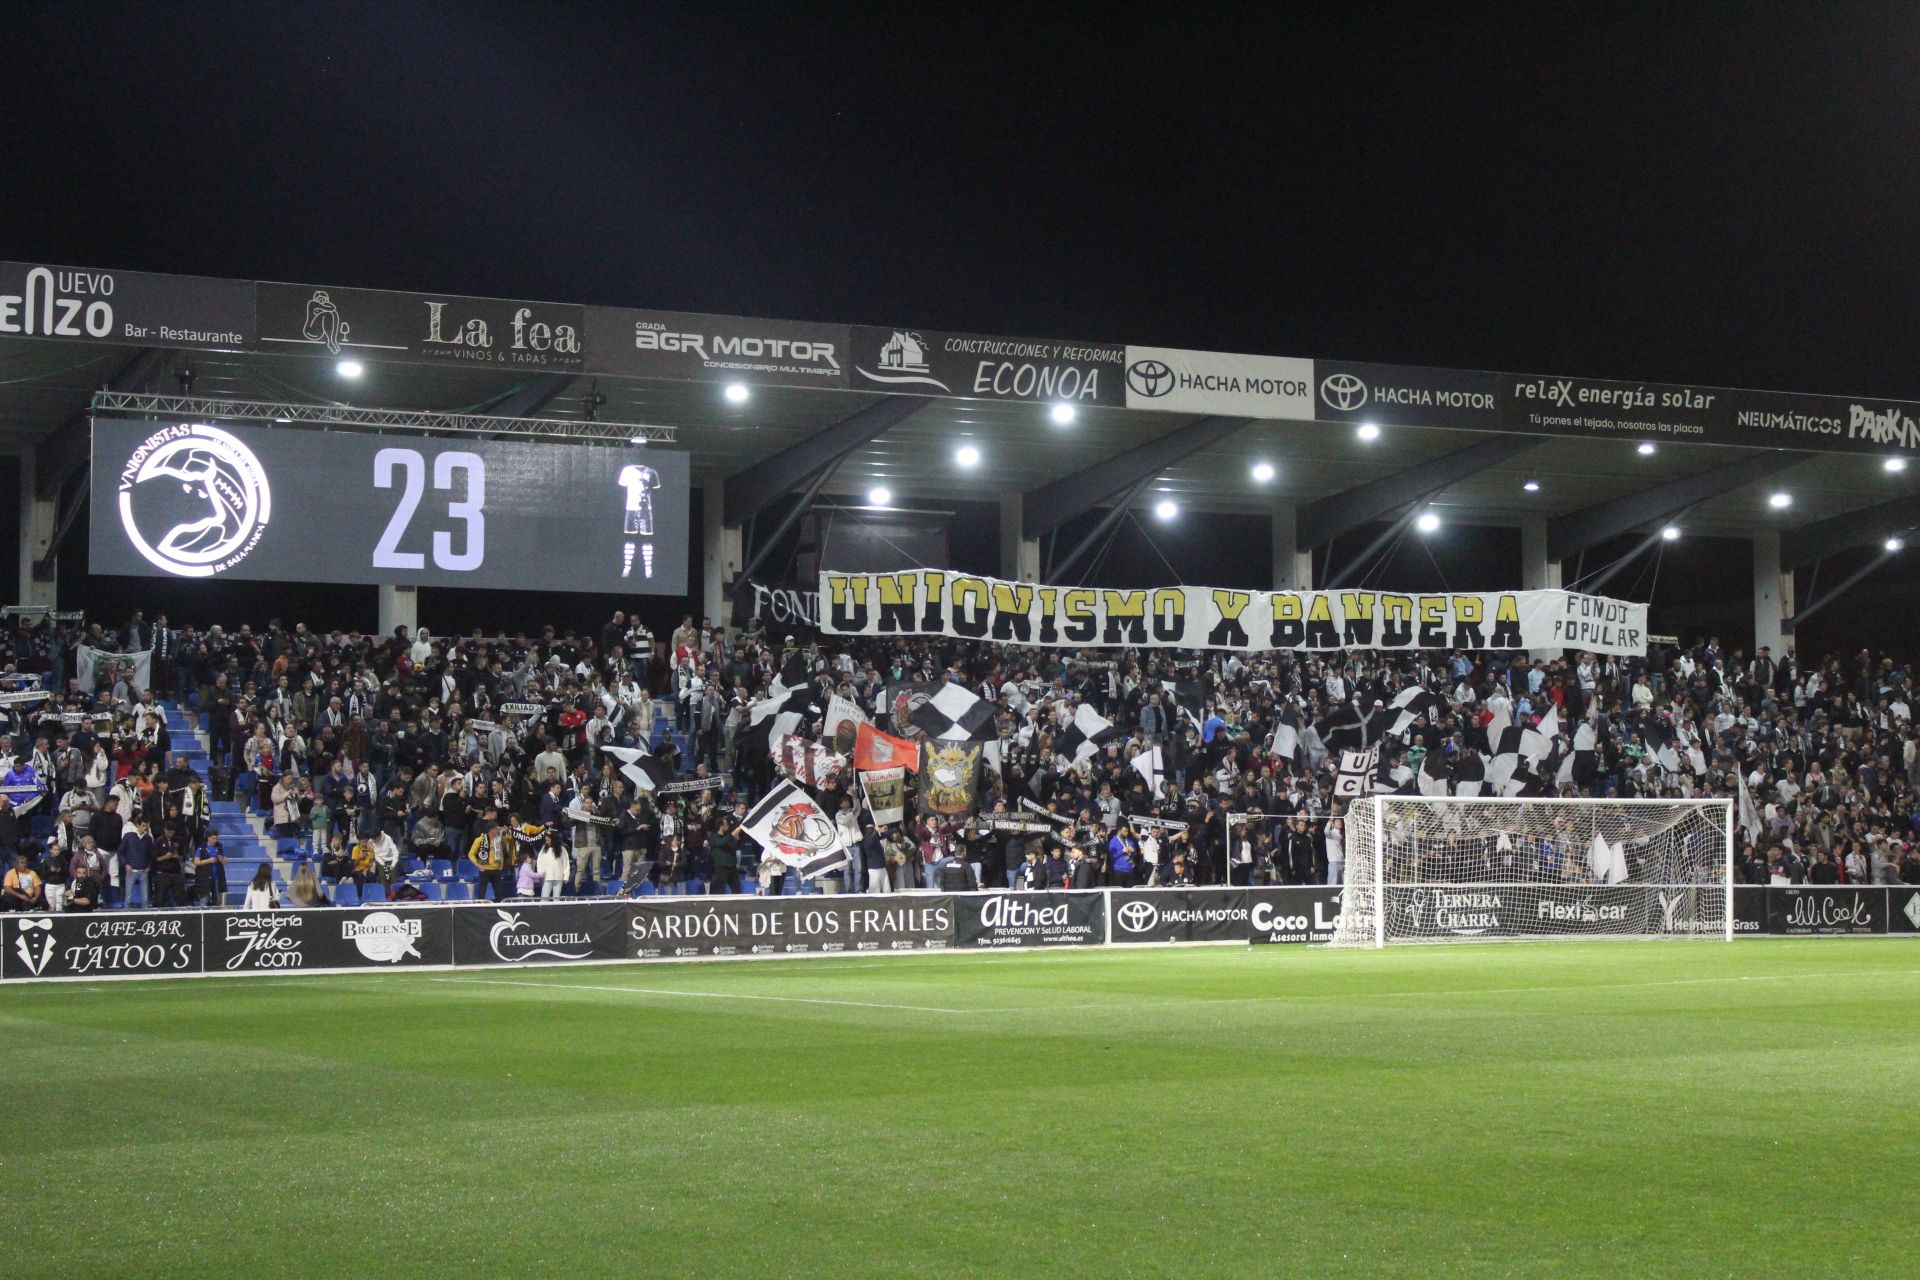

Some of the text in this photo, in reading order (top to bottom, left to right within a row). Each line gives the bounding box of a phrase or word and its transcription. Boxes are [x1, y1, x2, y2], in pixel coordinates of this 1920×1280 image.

[125, 323, 147, 337] Bar
[160, 326, 243, 344] Restaurante
[422, 301, 581, 354] La fea
[635, 321, 666, 331] GRADA
[454, 350, 493, 361] VINOS
[512, 353, 547, 364] TAPAS
[713, 335, 840, 369] MOTOR
[945, 338, 1125, 363] CONSTRUCCIONES Y REFORMAS
[973, 360, 1099, 400] ECONOA
[1180, 372, 1308, 397] HACHA MOTOR
[1374, 386, 1495, 410] HACHA MOTOR
[1578, 386, 1655, 410] energía
[1661, 389, 1716, 409] solar
[1529, 414, 1704, 435] Tú pones el tejado, nosotros las placas
[1737, 410, 1842, 435] NEUMÁTICOS
[372, 447, 486, 571] 23
[828, 573, 1524, 649] UNIONISMO X BANDERA
[1566, 595, 1629, 624] FONDO
[1553, 620, 1640, 647] POPULAR
[1432, 889, 1502, 908] TERNERA
[631, 906, 949, 940] SARDÓN DE LOS FRAILES
[1161, 909, 1248, 922] HACHA MOTOR
[1437, 908, 1500, 927] CHARRA
[1733, 919, 1760, 930] Grass
[86, 920, 185, 938] CAFE-BAR
[344, 921, 420, 937] BROCENSE
[503, 932, 592, 946] TARDAGUILA
[994, 927, 1035, 935] PREVENCION
[1270, 932, 1306, 942] Asesora
[226, 927, 303, 969] Jibe
[254, 951, 302, 967] .com
